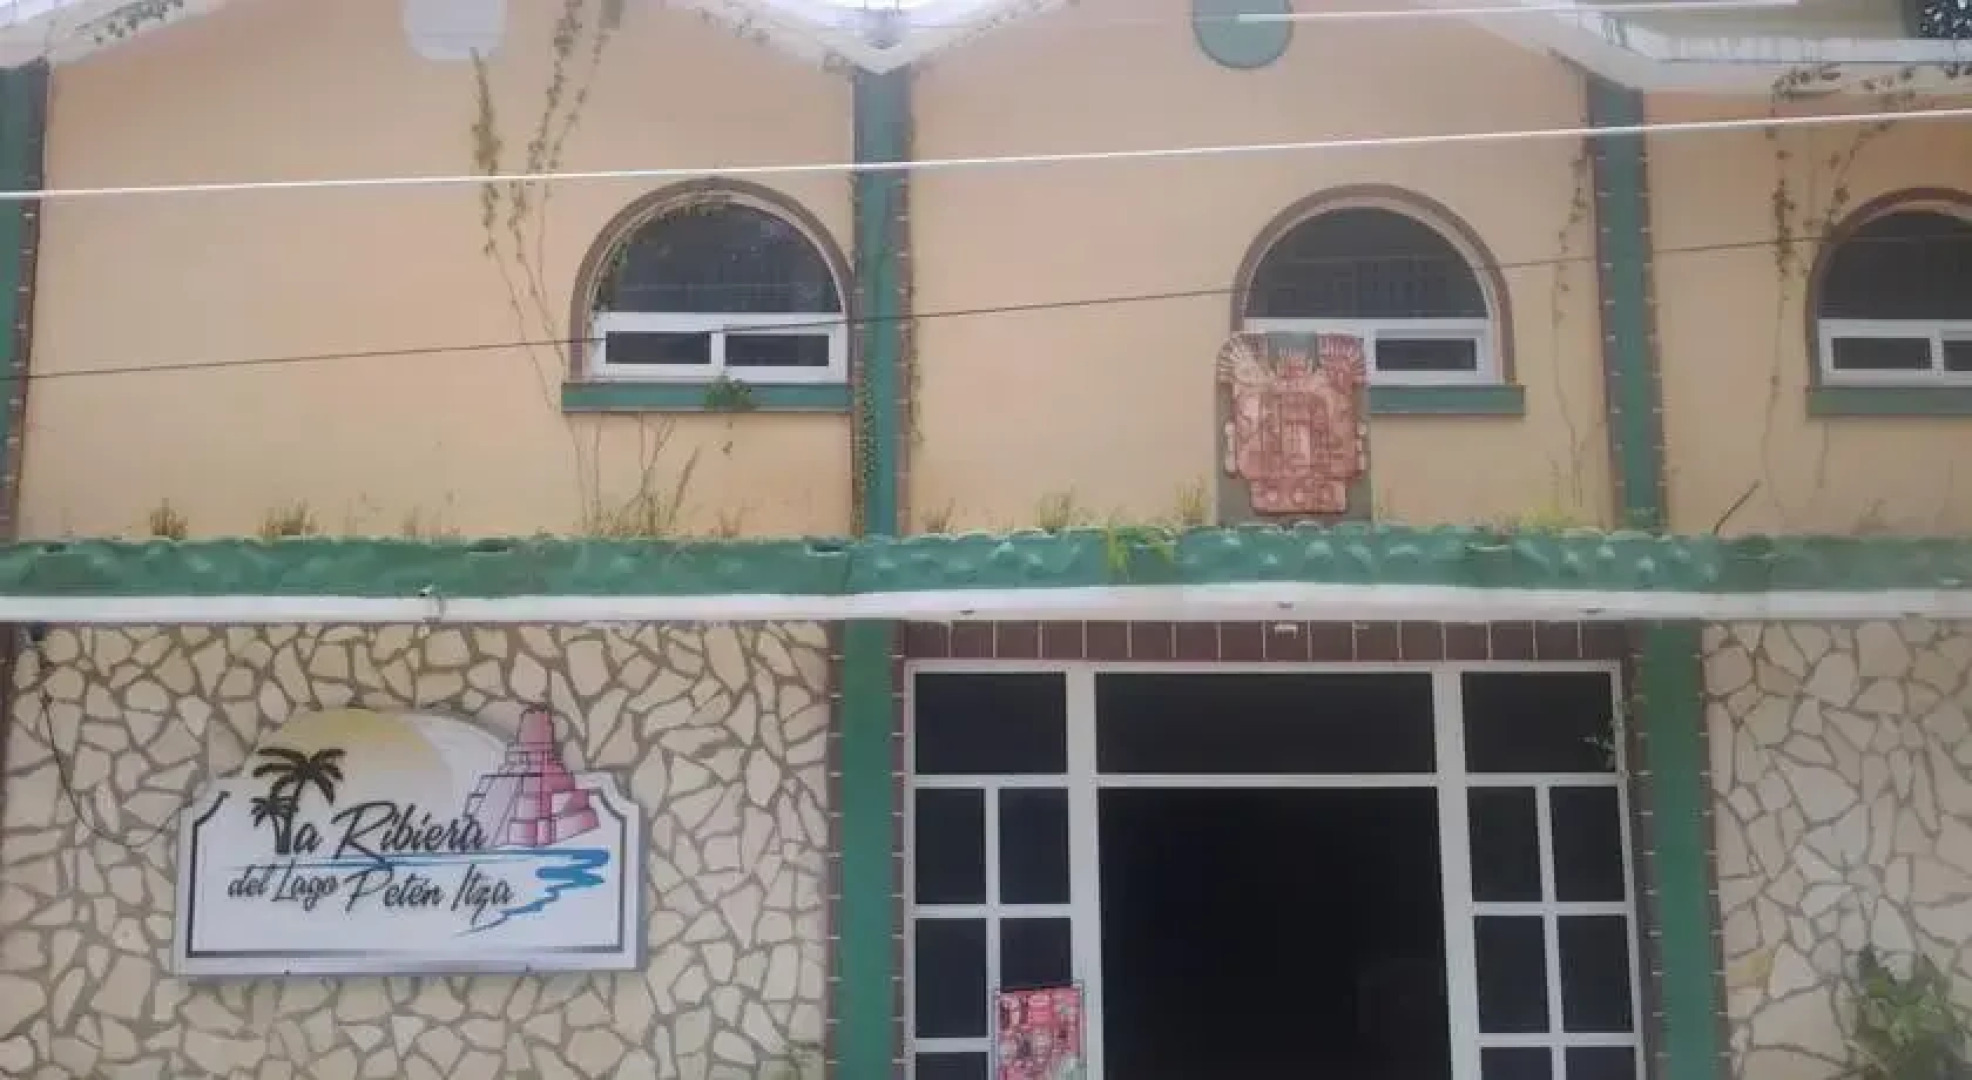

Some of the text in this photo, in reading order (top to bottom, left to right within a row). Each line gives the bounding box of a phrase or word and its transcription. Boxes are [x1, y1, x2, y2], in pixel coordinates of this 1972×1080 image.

[331, 801, 488, 864] Ribiera
[228, 864, 276, 897] del
[270, 858, 339, 911] Lago
[344, 865, 446, 912] Petén
